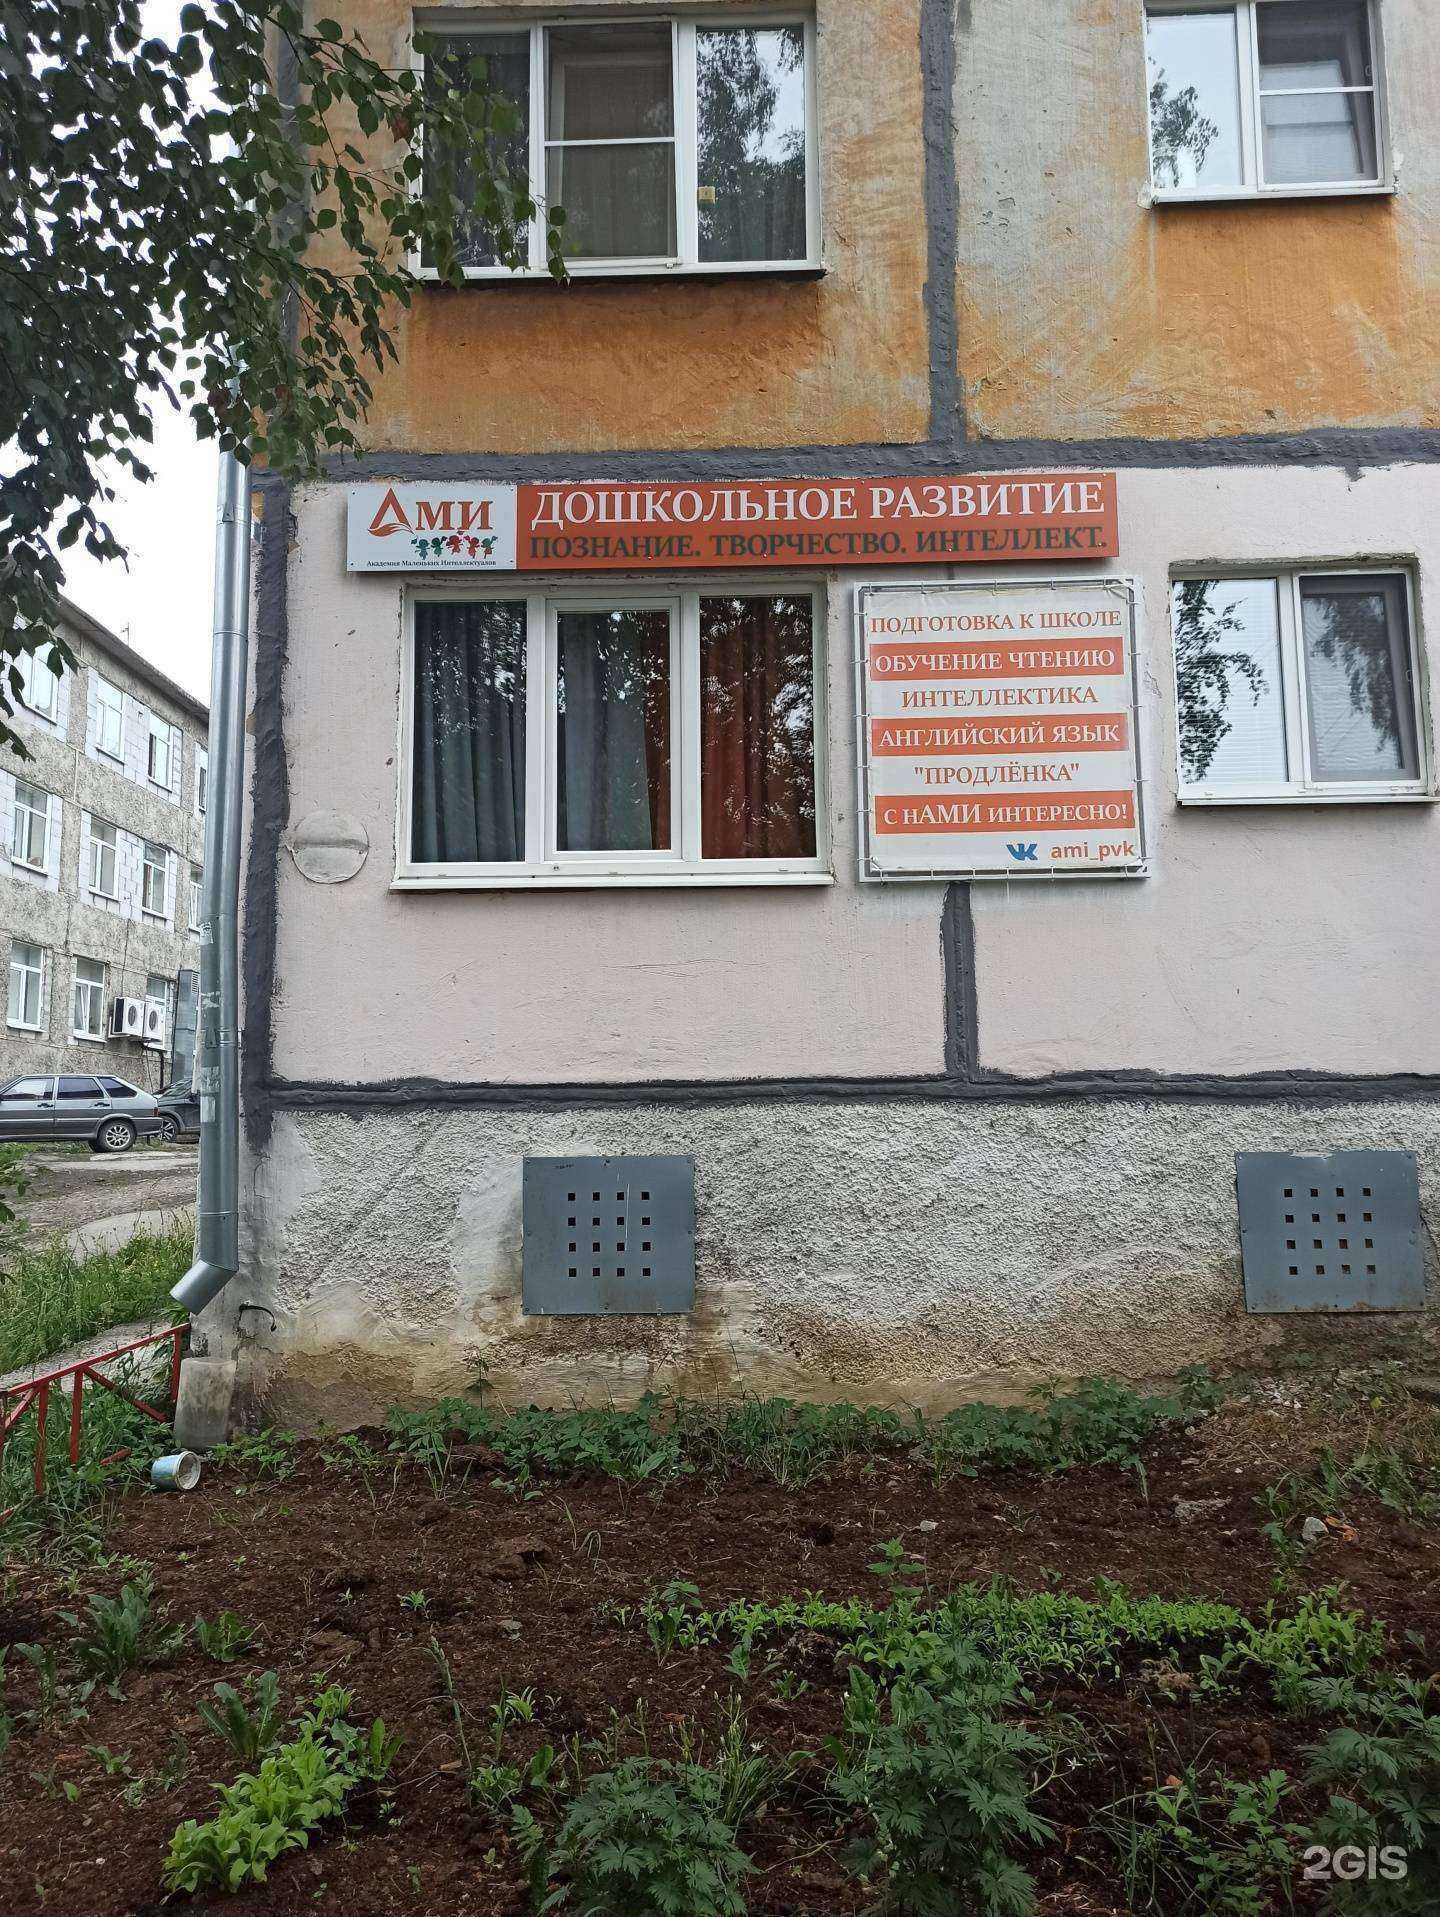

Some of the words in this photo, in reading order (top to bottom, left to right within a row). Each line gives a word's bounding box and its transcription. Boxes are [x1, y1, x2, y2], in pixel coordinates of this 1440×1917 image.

[531, 487, 857, 531] ДОШКОЛЬНОЕ
[869, 481, 1104, 518] РАЗВИТИЕ
[530, 534, 701, 560] ПОЗНАНИЕ.
[709, 531, 906, 558] ТВОРЧЕСТВО.
[916, 526, 1107, 554] ИНТЕЛЛЕКТ.
[402, 559, 439, 567] Маленьких
[441, 559, 496, 567] Интеллектуалов
[871, 614, 1013, 635] ПОДГОТОВКА
[1020, 613, 1035, 630] К
[1039, 610, 1122, 630] ШКОЛЕ
[875, 652, 1003, 673] ОБУЧЕНИЕ
[1009, 648, 1115, 669] ЧТЕНИЮ
[901, 686, 1098, 708] ИНТЕЛЛЕКТИКА
[879, 721, 1045, 747] АНГЛИЙСКИЙ
[1051, 724, 1120, 743] ЯЗЫК
[914, 762, 1080, 787] "ПРОДЛЁНКА"
[988, 803, 1128, 823] ИНТЕРЕСНО!
[1051, 840, 1135, 861] ami_pvk
